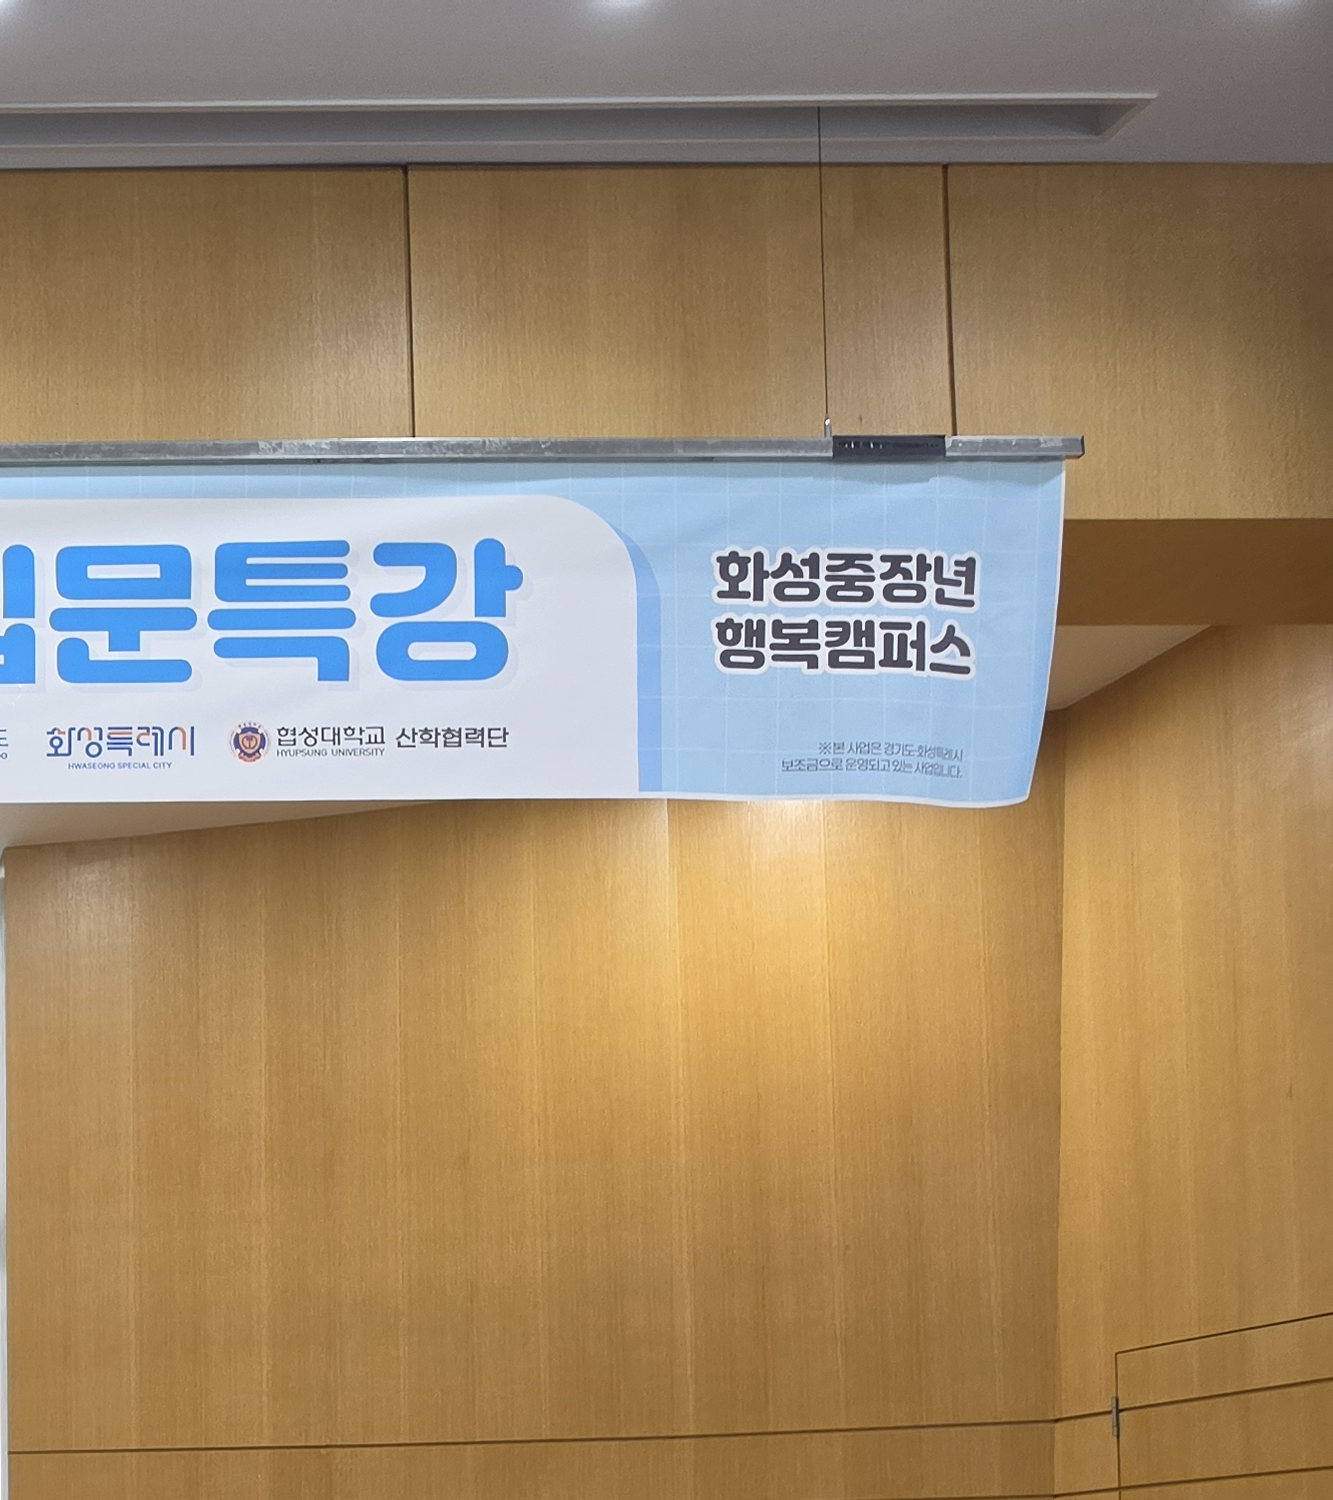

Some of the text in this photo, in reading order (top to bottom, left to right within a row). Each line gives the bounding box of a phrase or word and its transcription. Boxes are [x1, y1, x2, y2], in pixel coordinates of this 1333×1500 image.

[715, 550, 977, 609] 화성중장년
[714, 617, 975, 676] 행복캠퍼스
[46, 725, 196, 759] 화성특례시
[276, 725, 510, 749] 협성대학교 산학협력단
[67, 760, 173, 771] HWASEONG SPECIAL CITY
[276, 747, 386, 758] HYUPSUNG UNIVERSITY
